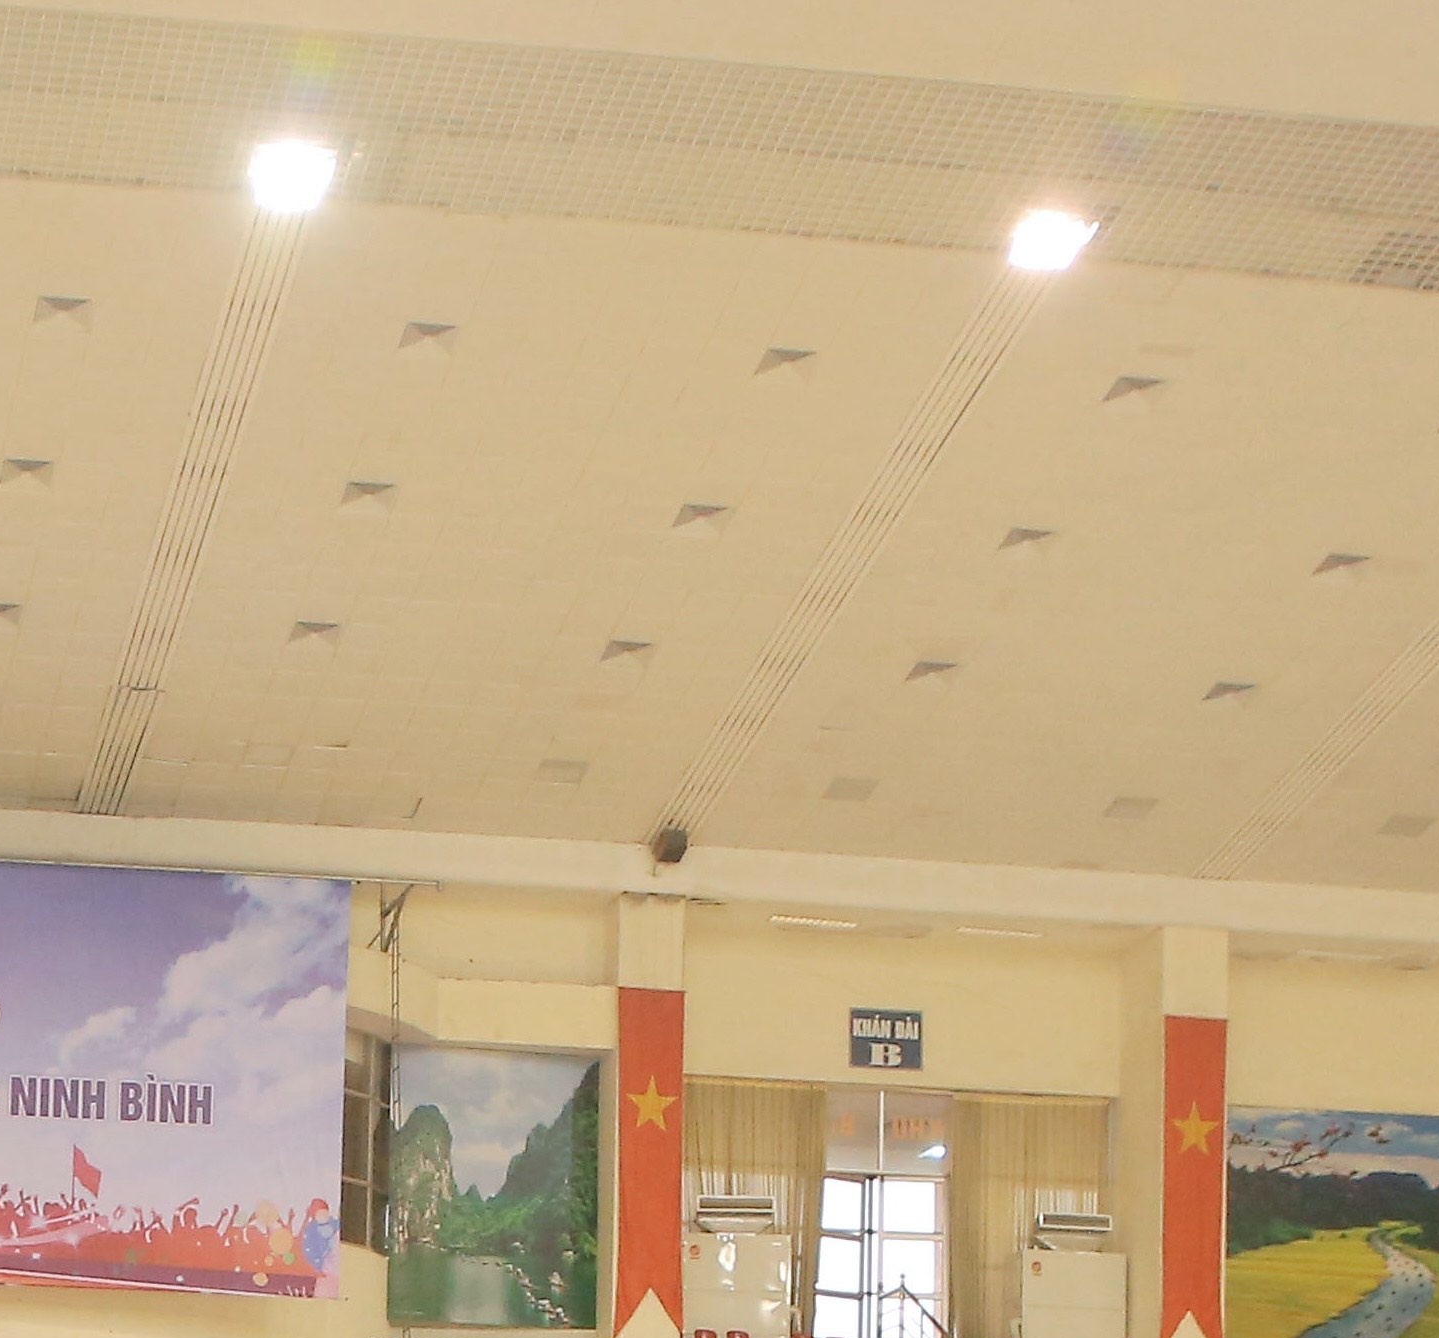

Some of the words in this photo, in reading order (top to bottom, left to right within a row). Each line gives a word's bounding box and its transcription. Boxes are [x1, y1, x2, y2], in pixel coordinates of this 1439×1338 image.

[869, 1042, 902, 1066] B
[9, 1075, 105, 1121] NINH
[118, 1070, 213, 1126] BÌNH
